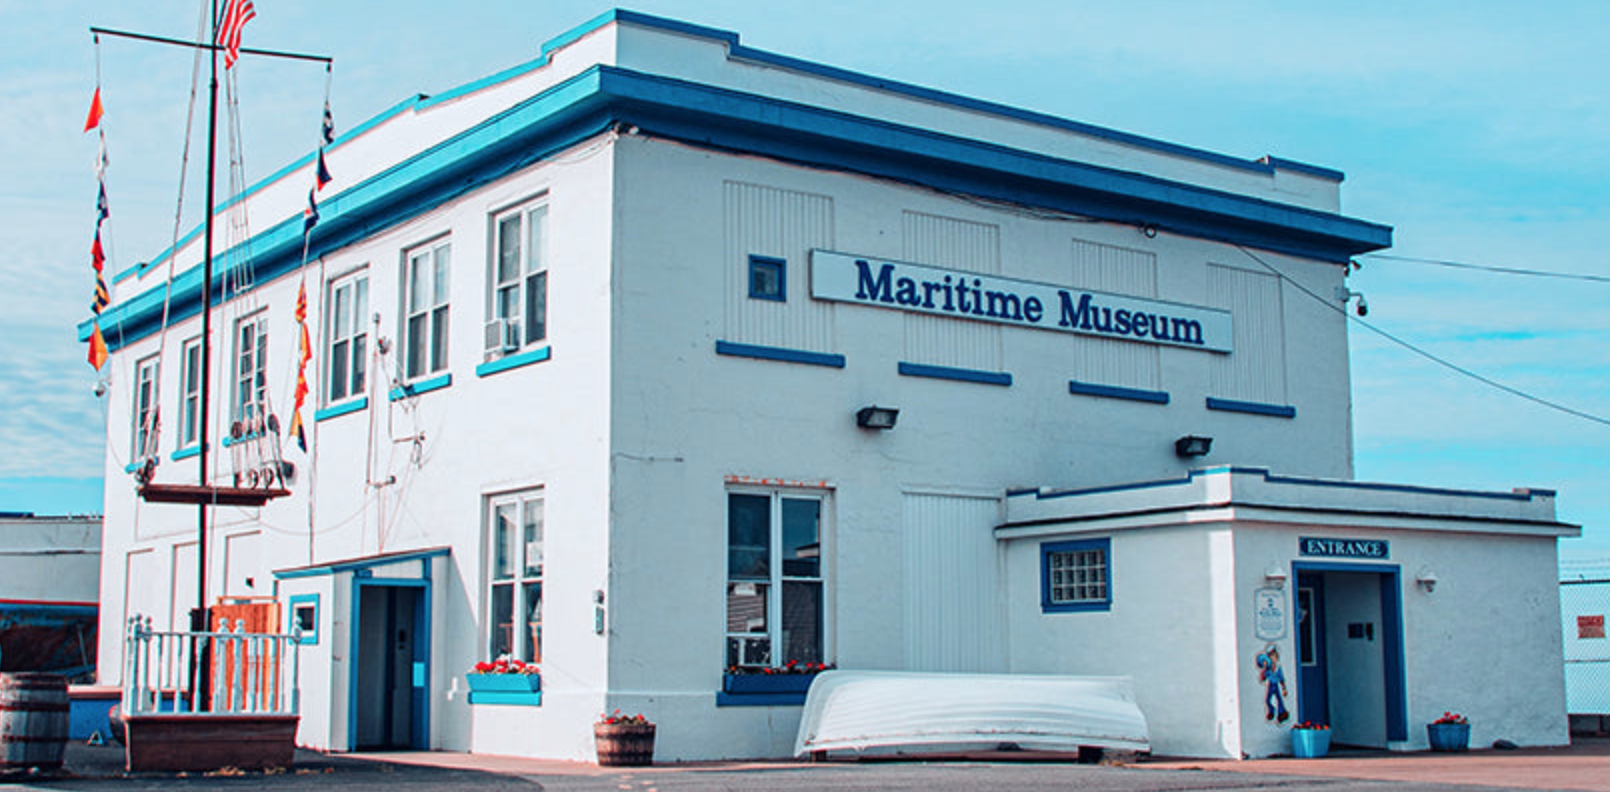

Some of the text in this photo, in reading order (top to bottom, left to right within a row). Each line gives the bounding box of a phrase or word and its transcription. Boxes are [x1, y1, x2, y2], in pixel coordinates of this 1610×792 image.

[855, 260, 1204, 344] Maritime Museum
[1307, 540, 1382, 556] ENTRANCE
